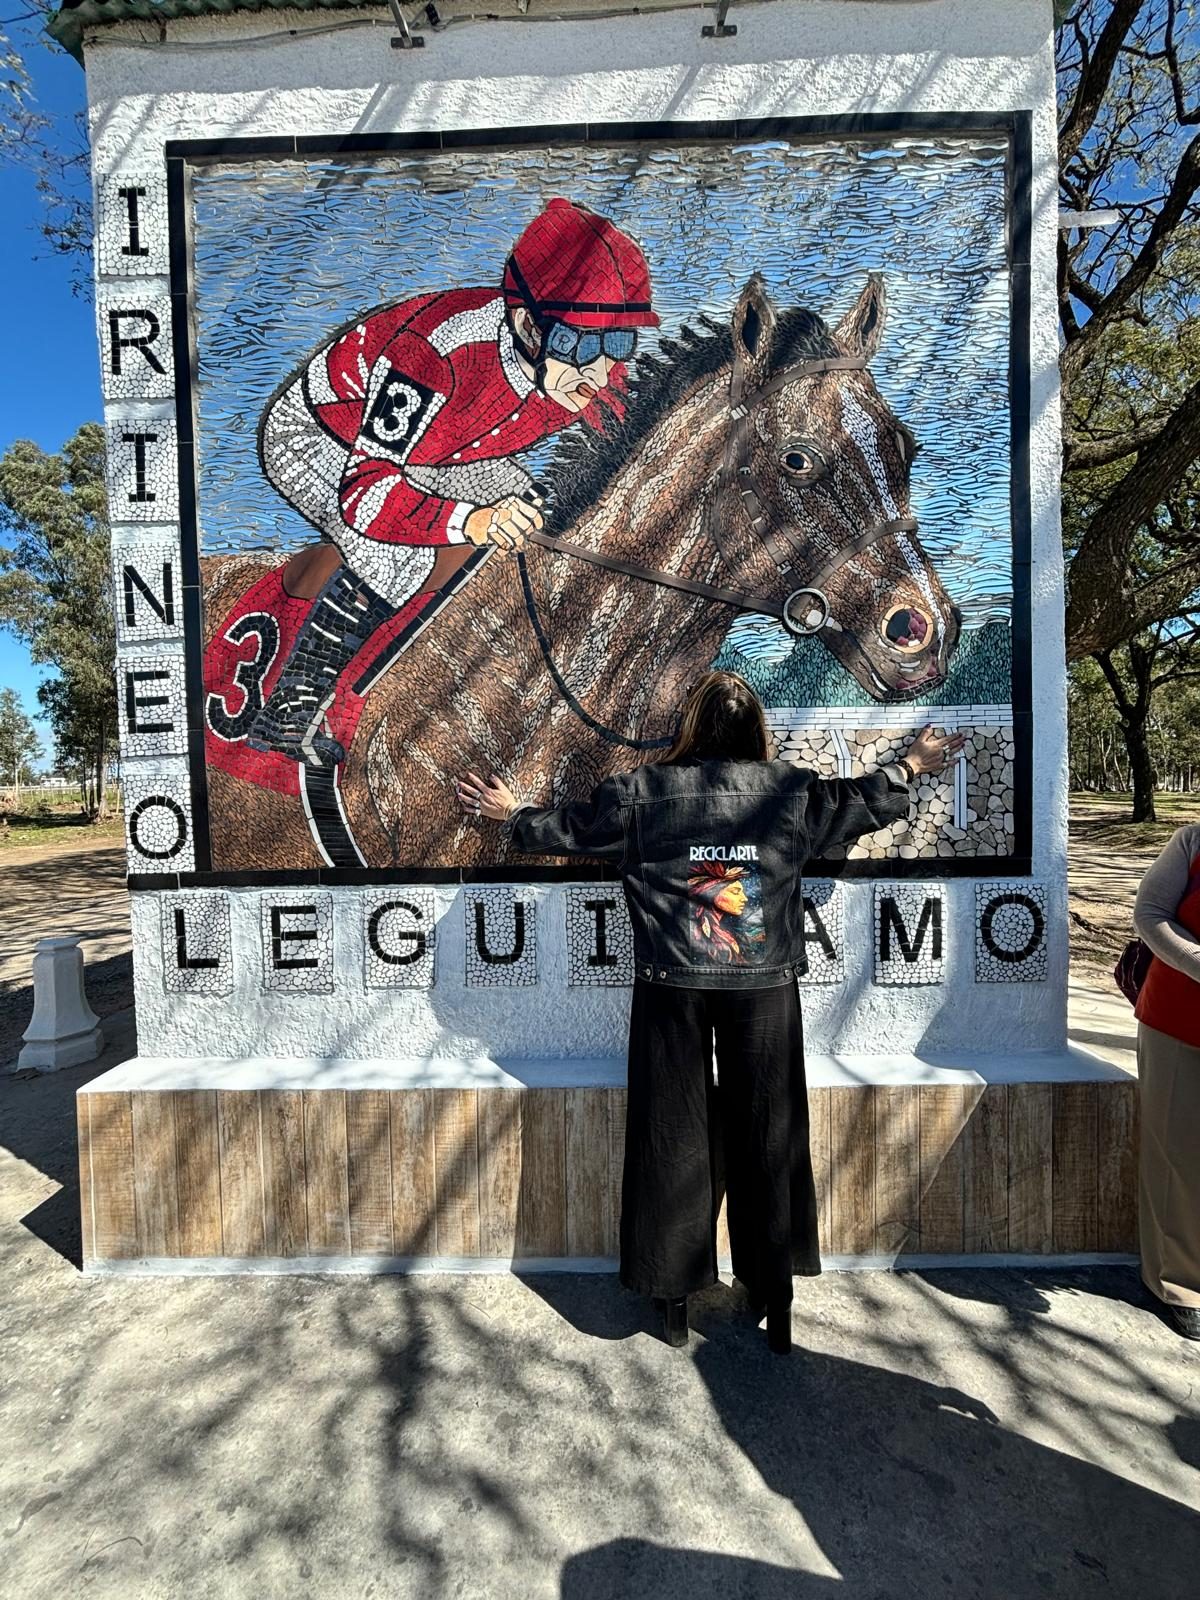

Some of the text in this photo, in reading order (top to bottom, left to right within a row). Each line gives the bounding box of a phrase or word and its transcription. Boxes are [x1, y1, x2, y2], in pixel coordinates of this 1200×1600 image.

[373, 382, 421, 442] 3
[109, 187, 186, 860] IRINEO
[206, 612, 280, 742] 3
[690, 845, 759, 861] RECICLARTE
[175, 893, 1044, 969] LEGUIAMO
